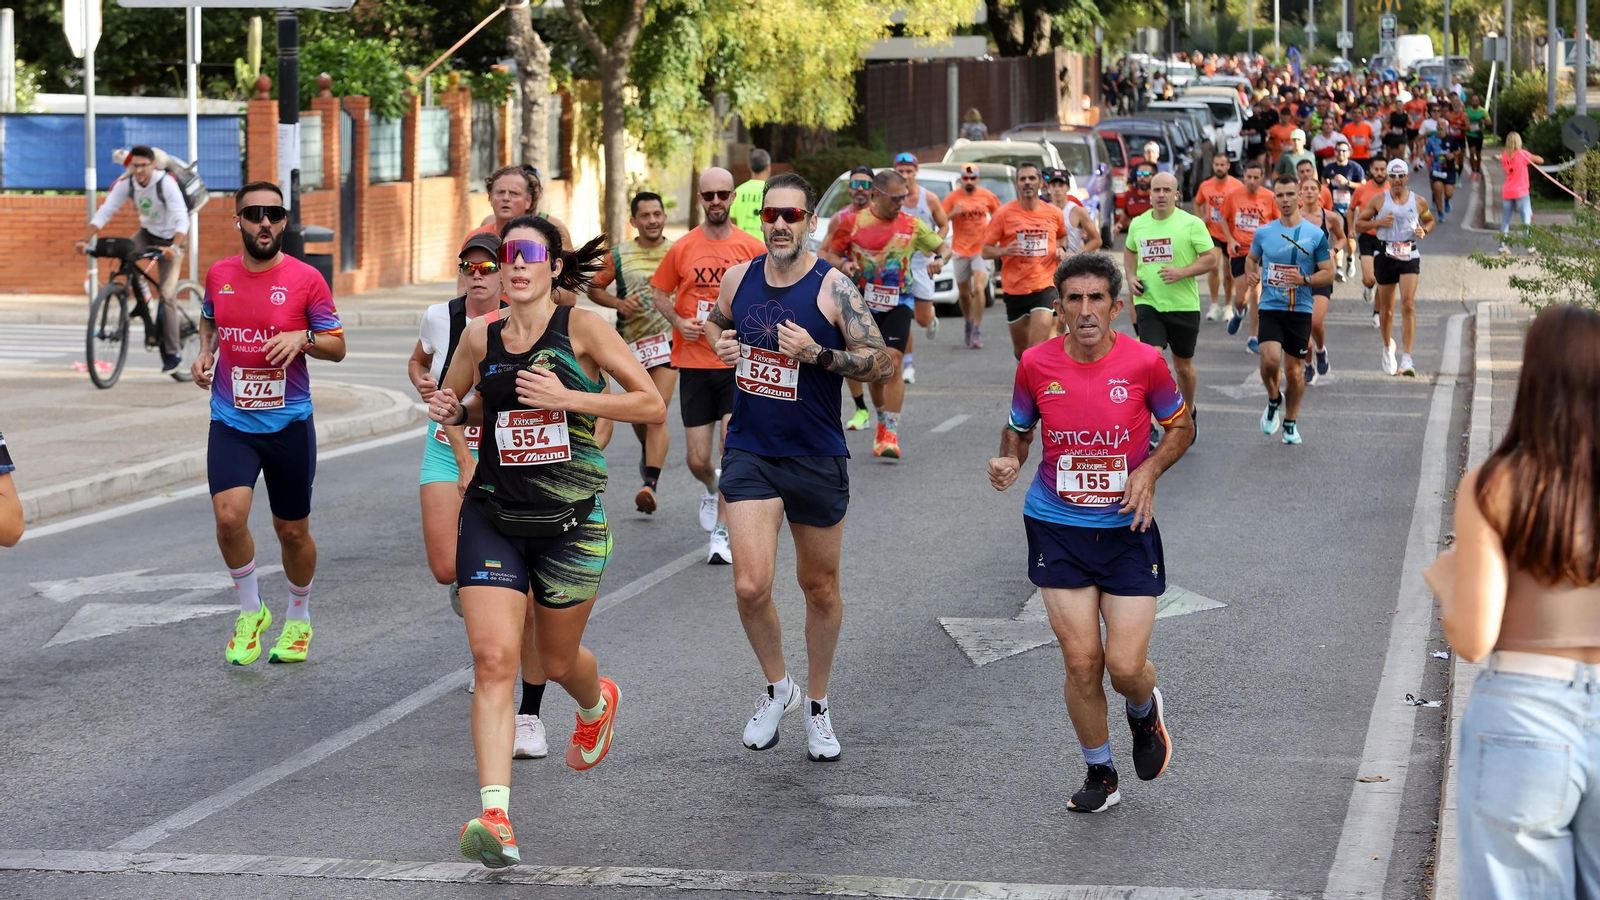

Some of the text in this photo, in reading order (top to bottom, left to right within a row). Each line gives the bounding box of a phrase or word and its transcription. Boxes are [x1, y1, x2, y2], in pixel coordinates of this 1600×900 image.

[1026, 241, 1041, 249] 279
[1149, 246, 1165, 255] 470
[872, 294, 891, 303] 370
[639, 346, 659, 359] 339
[749, 362, 782, 384] 543
[243, 382, 272, 396] 474
[511, 427, 550, 447] 554
[1075, 472, 1110, 490] 155
